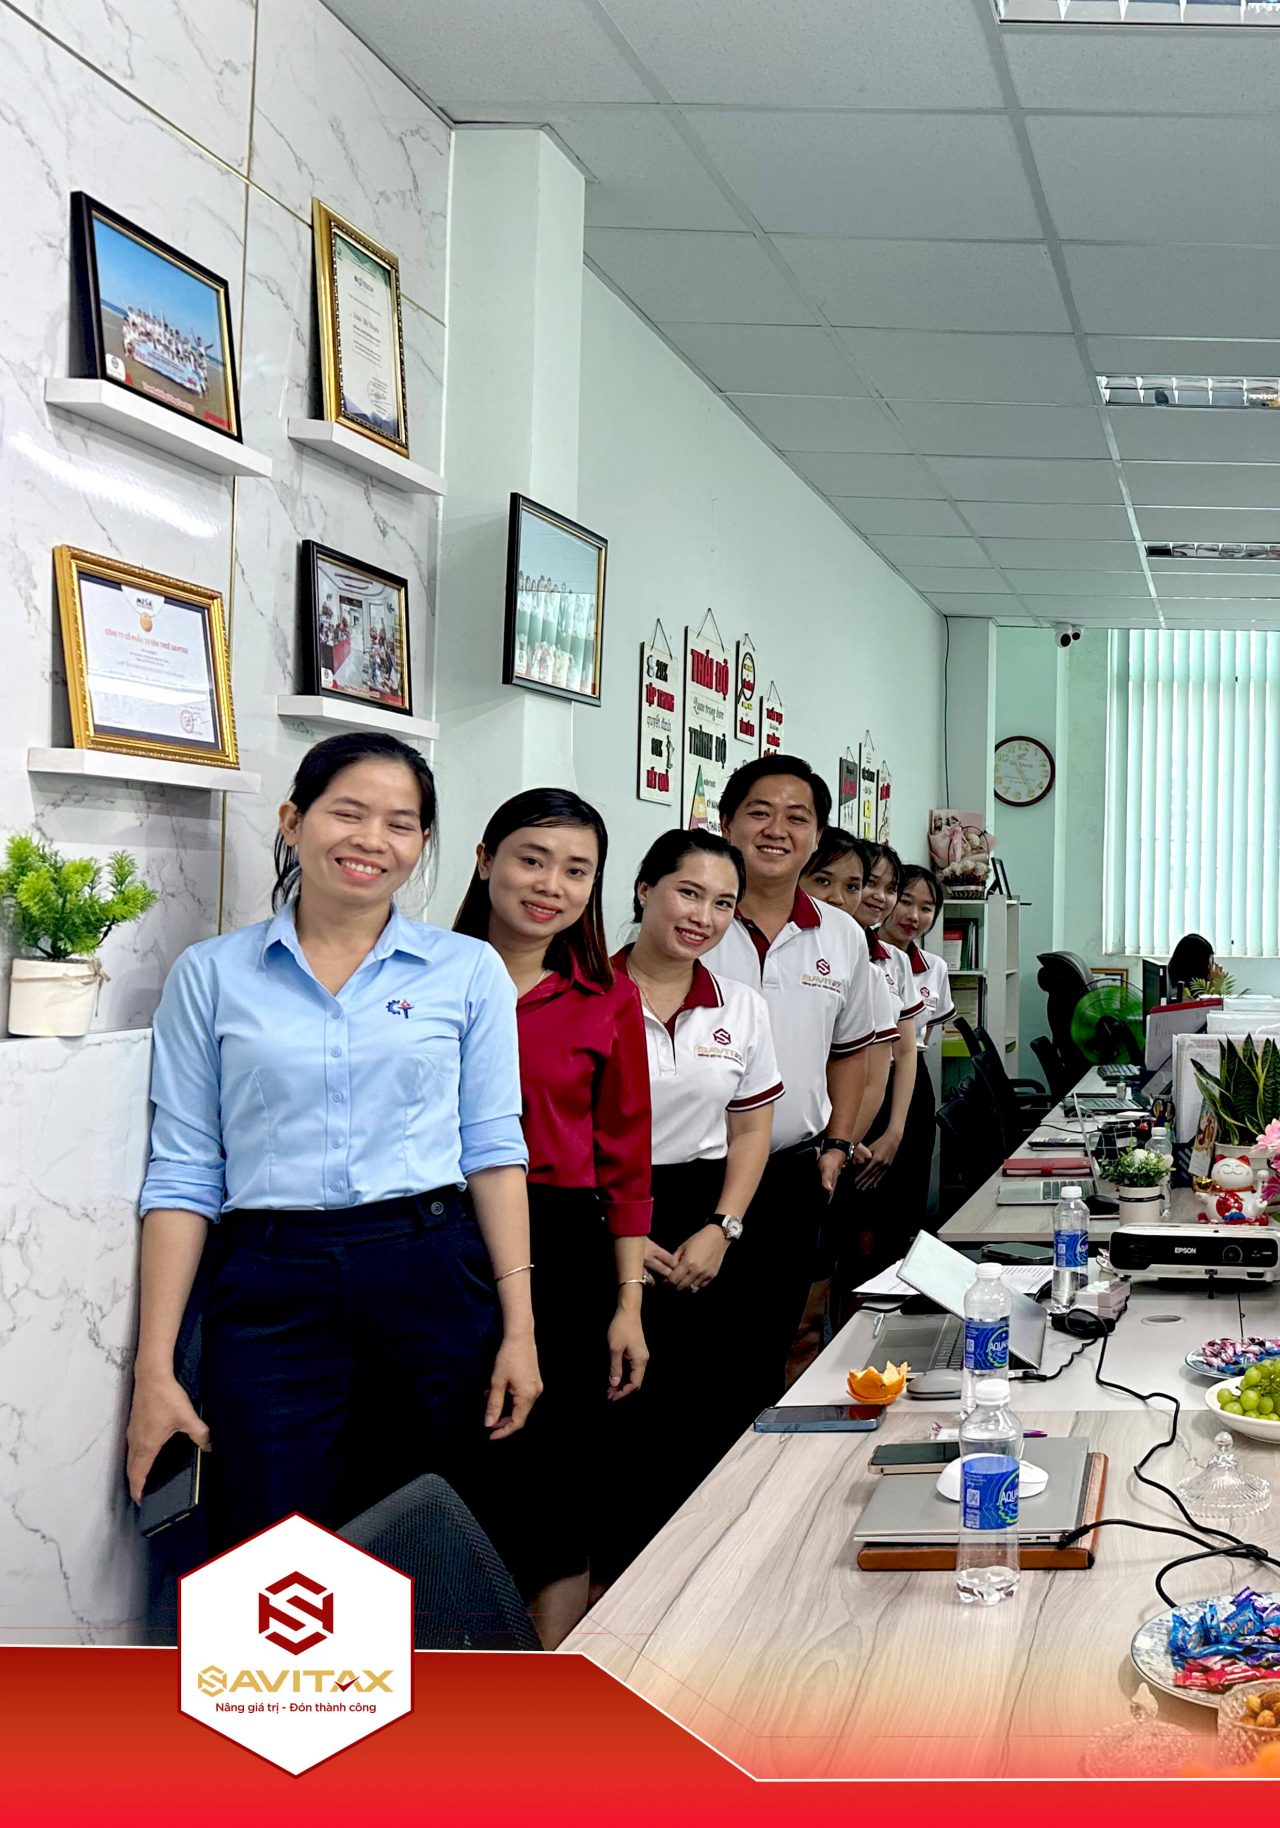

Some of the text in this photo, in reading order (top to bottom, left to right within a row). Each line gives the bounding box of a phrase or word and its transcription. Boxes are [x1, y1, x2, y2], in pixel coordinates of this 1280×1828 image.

[691, 648, 729, 701] THÁI ĐỘ
[715, 733, 727, 769] ĐỘ
